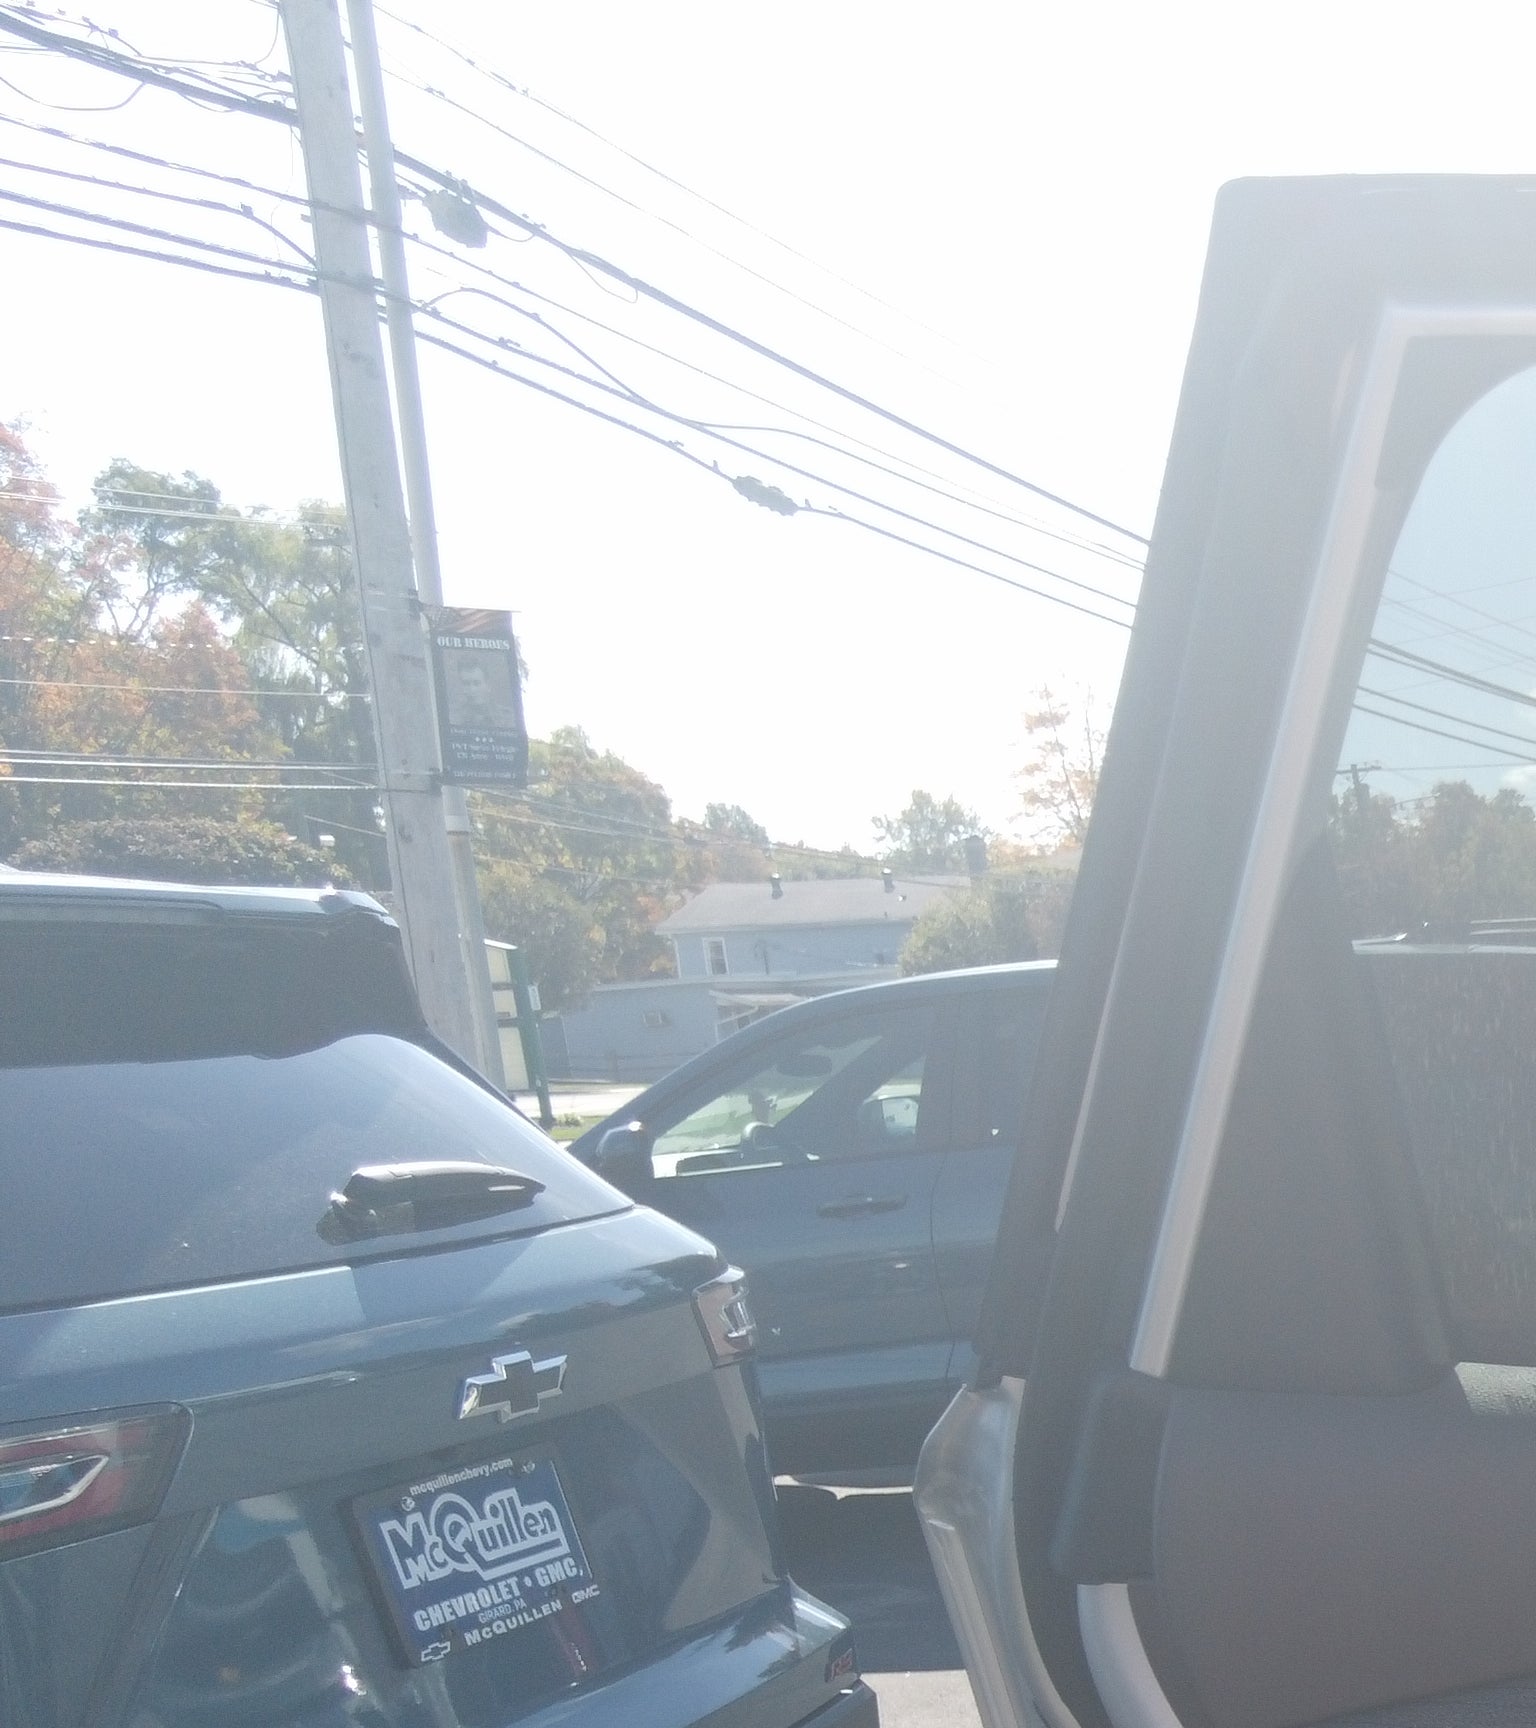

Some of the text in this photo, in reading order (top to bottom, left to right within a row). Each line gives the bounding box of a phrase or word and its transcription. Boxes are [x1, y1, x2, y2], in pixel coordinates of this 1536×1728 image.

[437, 635, 510, 650] OUR HEROES
[379, 1487, 571, 1590] McQuillen
[413, 1575, 521, 1632] CHEVROLET
[571, 1585, 600, 1604] GMC
